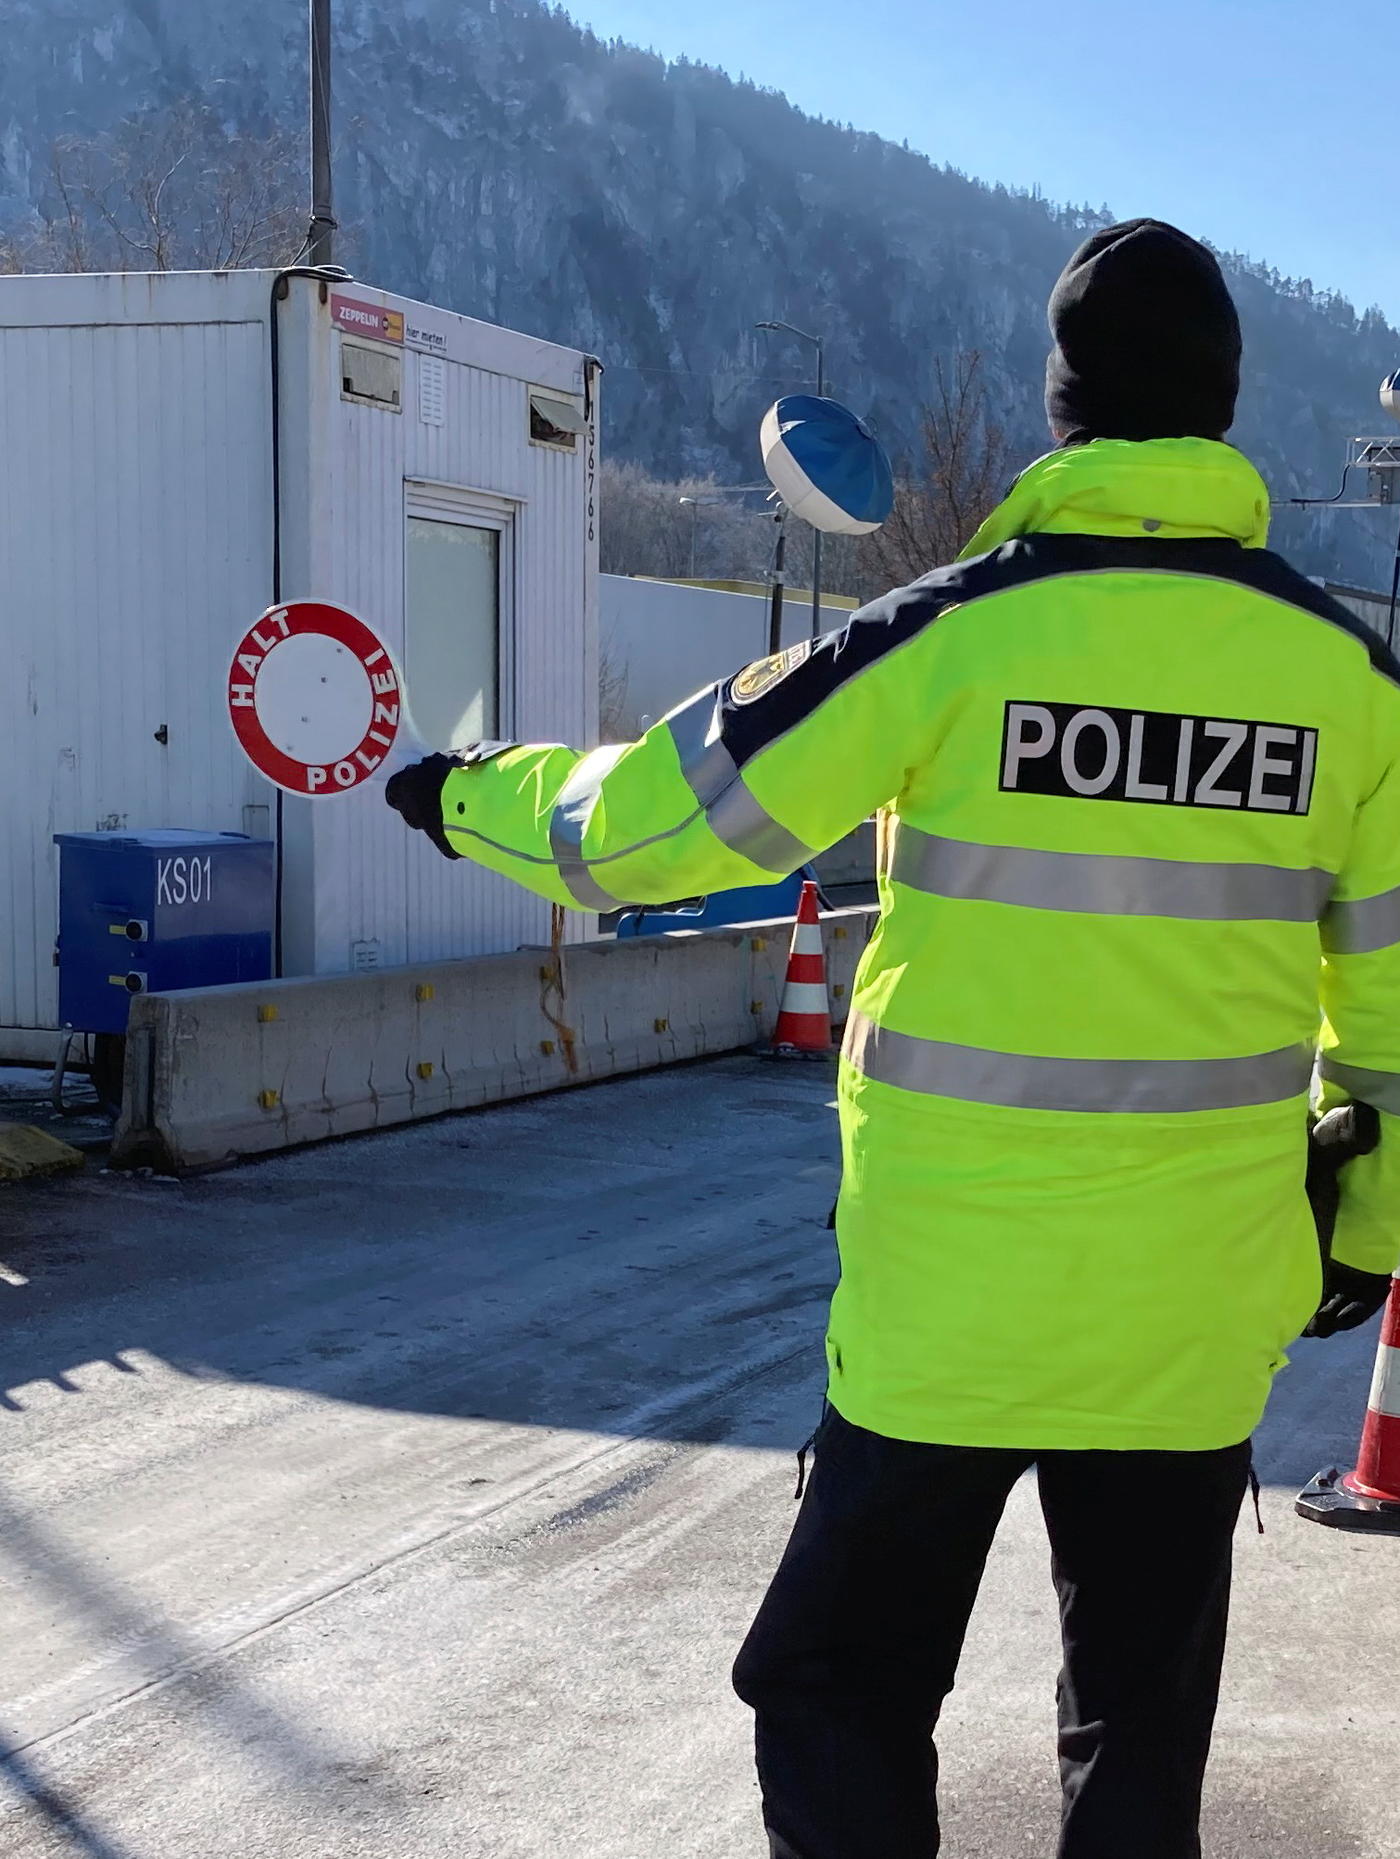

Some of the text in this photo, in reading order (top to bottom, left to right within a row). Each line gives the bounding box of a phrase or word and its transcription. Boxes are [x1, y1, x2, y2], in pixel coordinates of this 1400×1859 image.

[340, 306, 379, 328] ZEPPELIN
[406, 324, 420, 338] hier
[230, 609, 291, 707] HALT
[306, 647, 399, 792] POLIZEI
[1002, 703, 1316, 814] POLIZEI
[157, 855, 212, 906] KS01
